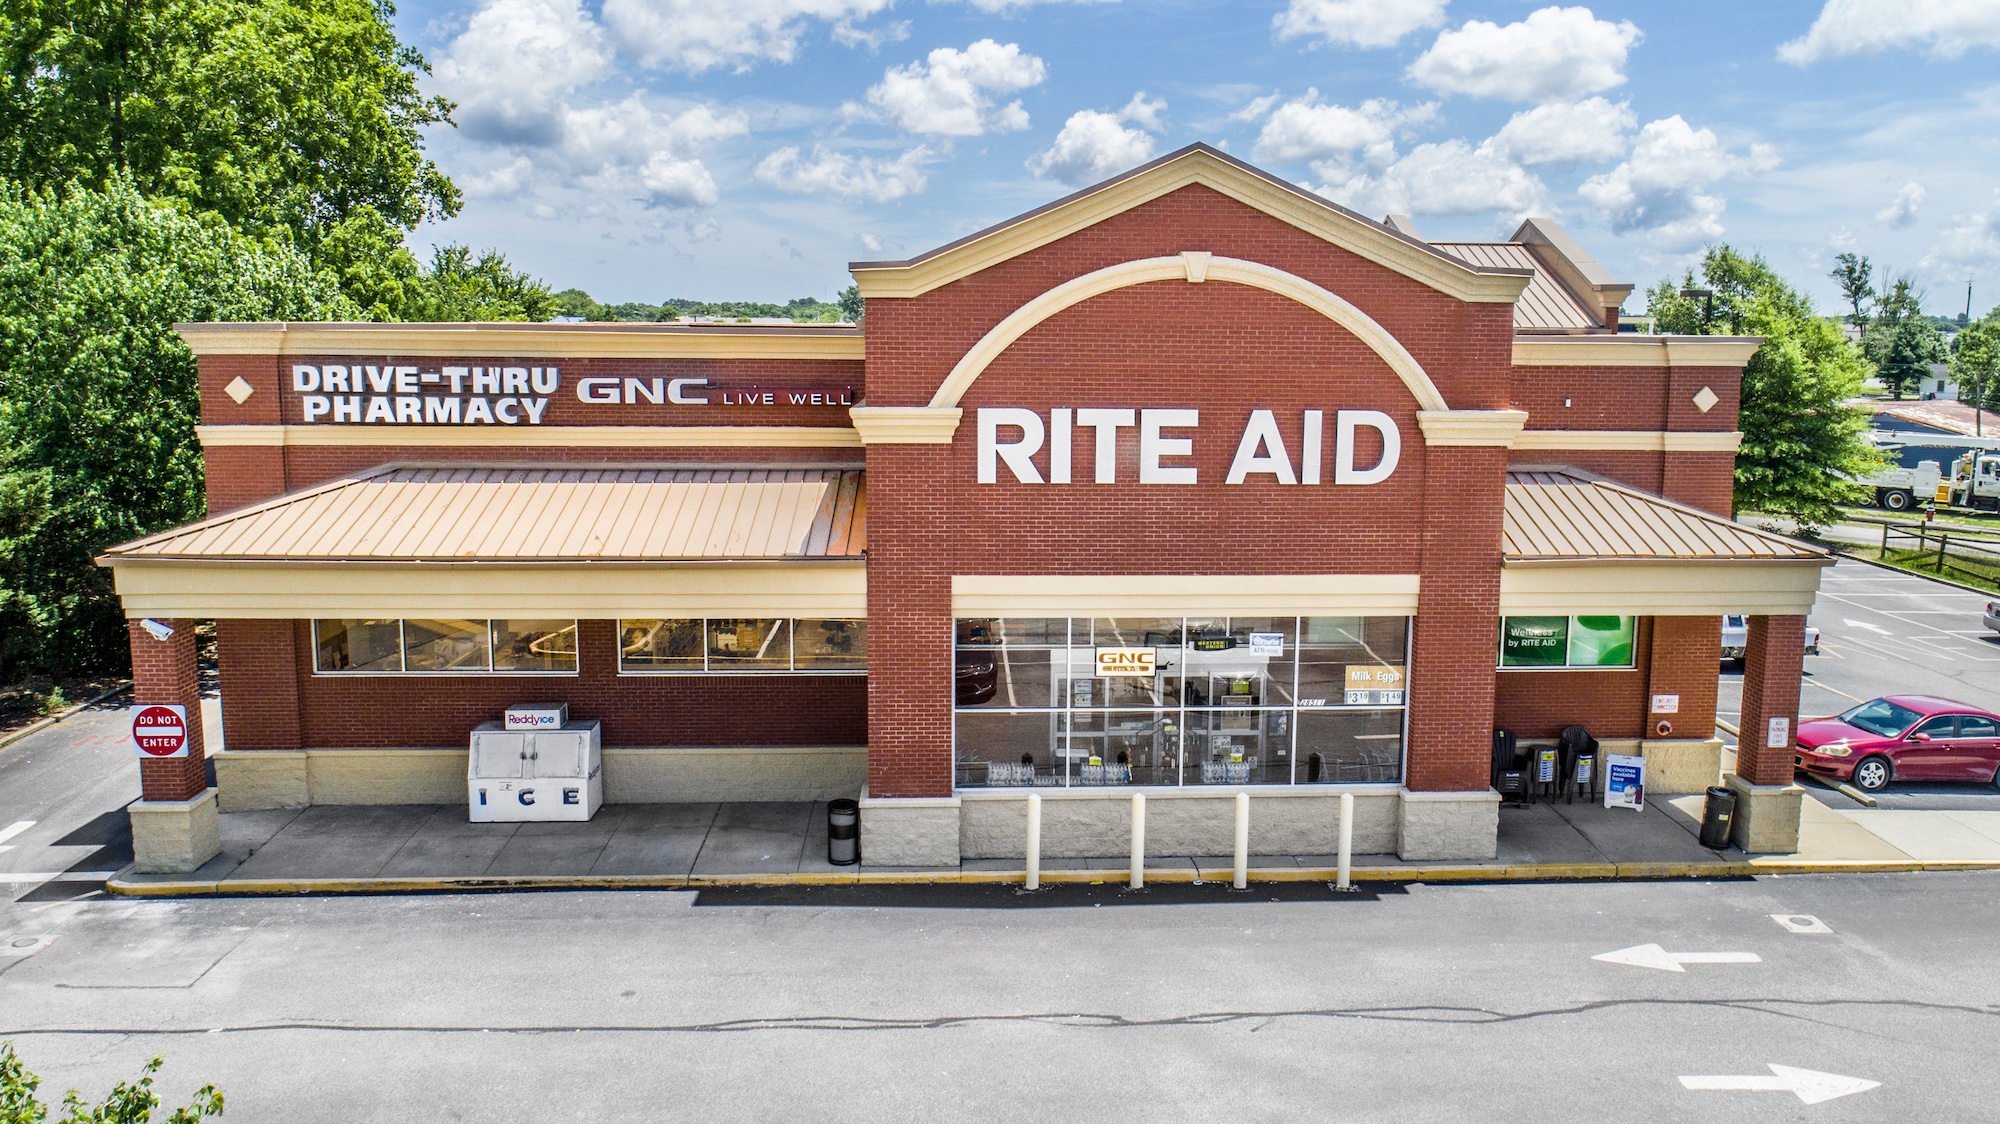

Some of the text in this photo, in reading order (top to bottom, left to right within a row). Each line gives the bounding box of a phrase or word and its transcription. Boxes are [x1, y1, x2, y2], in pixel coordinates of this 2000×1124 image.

[292, 365, 559, 394] DRIVE-THRU
[576, 377, 709, 405] GNC
[723, 392, 852, 405] LIVE WELL
[302, 395, 549, 424] PHARMACY
[977, 407, 1402, 485] RITE AID
[1510, 628, 1554, 637] Wellness
[1508, 639, 1557, 648] by RITE AID
[1098, 652, 1154, 664] GNC
[1351, 671, 1400, 683] Milk Eggs
[139, 715, 178, 725] DO NOT
[142, 738, 178, 747] ENTER
[1612, 766, 1636, 774] Vaccines
